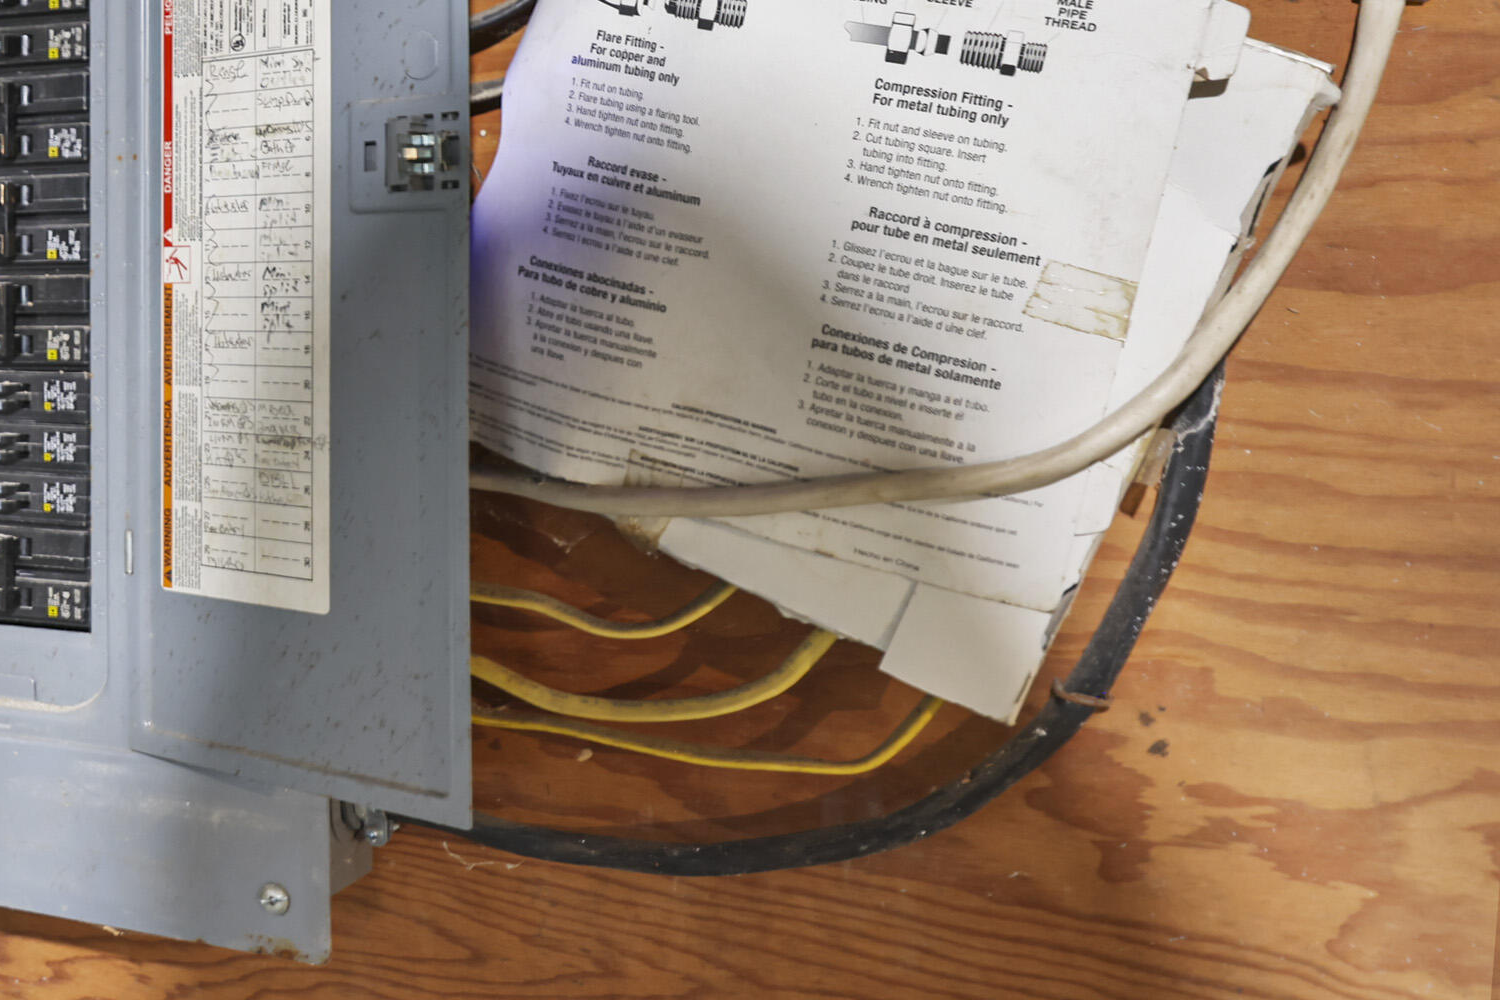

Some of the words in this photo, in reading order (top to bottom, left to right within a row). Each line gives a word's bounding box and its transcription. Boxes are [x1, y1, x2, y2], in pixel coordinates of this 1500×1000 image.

[1044, 16, 1098, 33] THREAD
[1057, 6, 1089, 21] PIPE
[589, 42, 608, 56] For
[608, 48, 646, 63] copper
[646, 55, 667, 68] and
[595, 29, 623, 45] Flare
[624, 34, 658, 54] Fitting
[570, 54, 622, 73] aluminum
[623, 63, 657, 83] tubing
[657, 72, 681, 87] only
[579, 77, 592, 90] Fit
[591, 81, 607, 93] nut
[616, 85, 646, 103] tubing.
[874, 77, 958, 102] Compression
[960, 91, 1004, 112] Fitting
[575, 104, 598, 118] Hand
[597, 109, 626, 124] tighten
[625, 116, 640, 128] nut
[639, 120, 659, 132] onto
[658, 122, 685, 140] fitting.
[577, 91, 599, 105] Flare
[599, 95, 625, 112] tubing
[624, 103, 648, 117] using
[654, 107, 681, 125] flaring
[681, 113, 701, 127] tool.
[872, 92, 894, 107] For
[895, 98, 934, 114] metal
[936, 103, 978, 124] tubing
[980, 112, 1010, 129] only
[573, 117, 604, 133] Wrench
[603, 124, 632, 140] tighten
[632, 132, 647, 144] nut
[645, 135, 666, 148] onto
[666, 138, 693, 155] fitting.
[864, 131, 883, 145] Cut
[884, 136, 917, 153] tubing
[917, 143, 955, 158] square.
[956, 148, 988, 164] Insert
[867, 117, 882, 130] Fit
[882, 122, 900, 134] nut
[900, 125, 922, 137] and
[921, 128, 956, 143] sleeve
[956, 135, 971, 145] on
[972, 136, 1008, 154] tubing.
[164, 141, 173, 194] DANGER
[587, 155, 629, 176] Raccord
[862, 146, 894, 164] tubing
[895, 152, 915, 165] into
[916, 155, 948, 174] fitting.
[552, 160, 586, 180] Tuyaux
[600, 175, 632, 191] cuivre
[645, 185, 701, 207] aluminum
[856, 174, 895, 191] Wrench
[895, 182, 931, 198] tighten
[931, 190, 951, 202] nut
[950, 194, 974, 207] onto
[975, 197, 1008, 215] fitting.
[858, 160, 886, 175] Hand
[887, 165, 922, 182] tighten
[923, 174, 941, 185] nut
[941, 177, 966, 190] onto
[967, 180, 999, 198] fitting.
[850, 220, 880, 236] pour
[882, 224, 912, 241] tube
[912, 232, 930, 245] en
[931, 234, 970, 254] metal
[970, 242, 1043, 268] seulement
[868, 206, 921, 228] Raccord
[922, 215, 932, 230] à
[933, 221, 1018, 248] compression
[517, 265, 540, 281] Para
[541, 271, 564, 288] tubo
[578, 284, 609, 300] cobre
[618, 294, 668, 314] aluminio
[529, 254, 585, 280] Conexiones
[585, 271, 647, 296] abocinadas
[164, 286, 173, 386] AVERTISSEMENT
[821, 323, 890, 351] Conexiones
[892, 341, 909, 355] de
[910, 345, 988, 373] Compresion
[810, 338, 839, 353] para
[841, 343, 875, 362] tubos
[877, 353, 894, 366] de
[895, 358, 933, 376] metal
[933, 367, 1002, 391] solamente
[164, 399, 173, 487] ADVERTENCIA
[164, 507, 173, 567] WARNING
